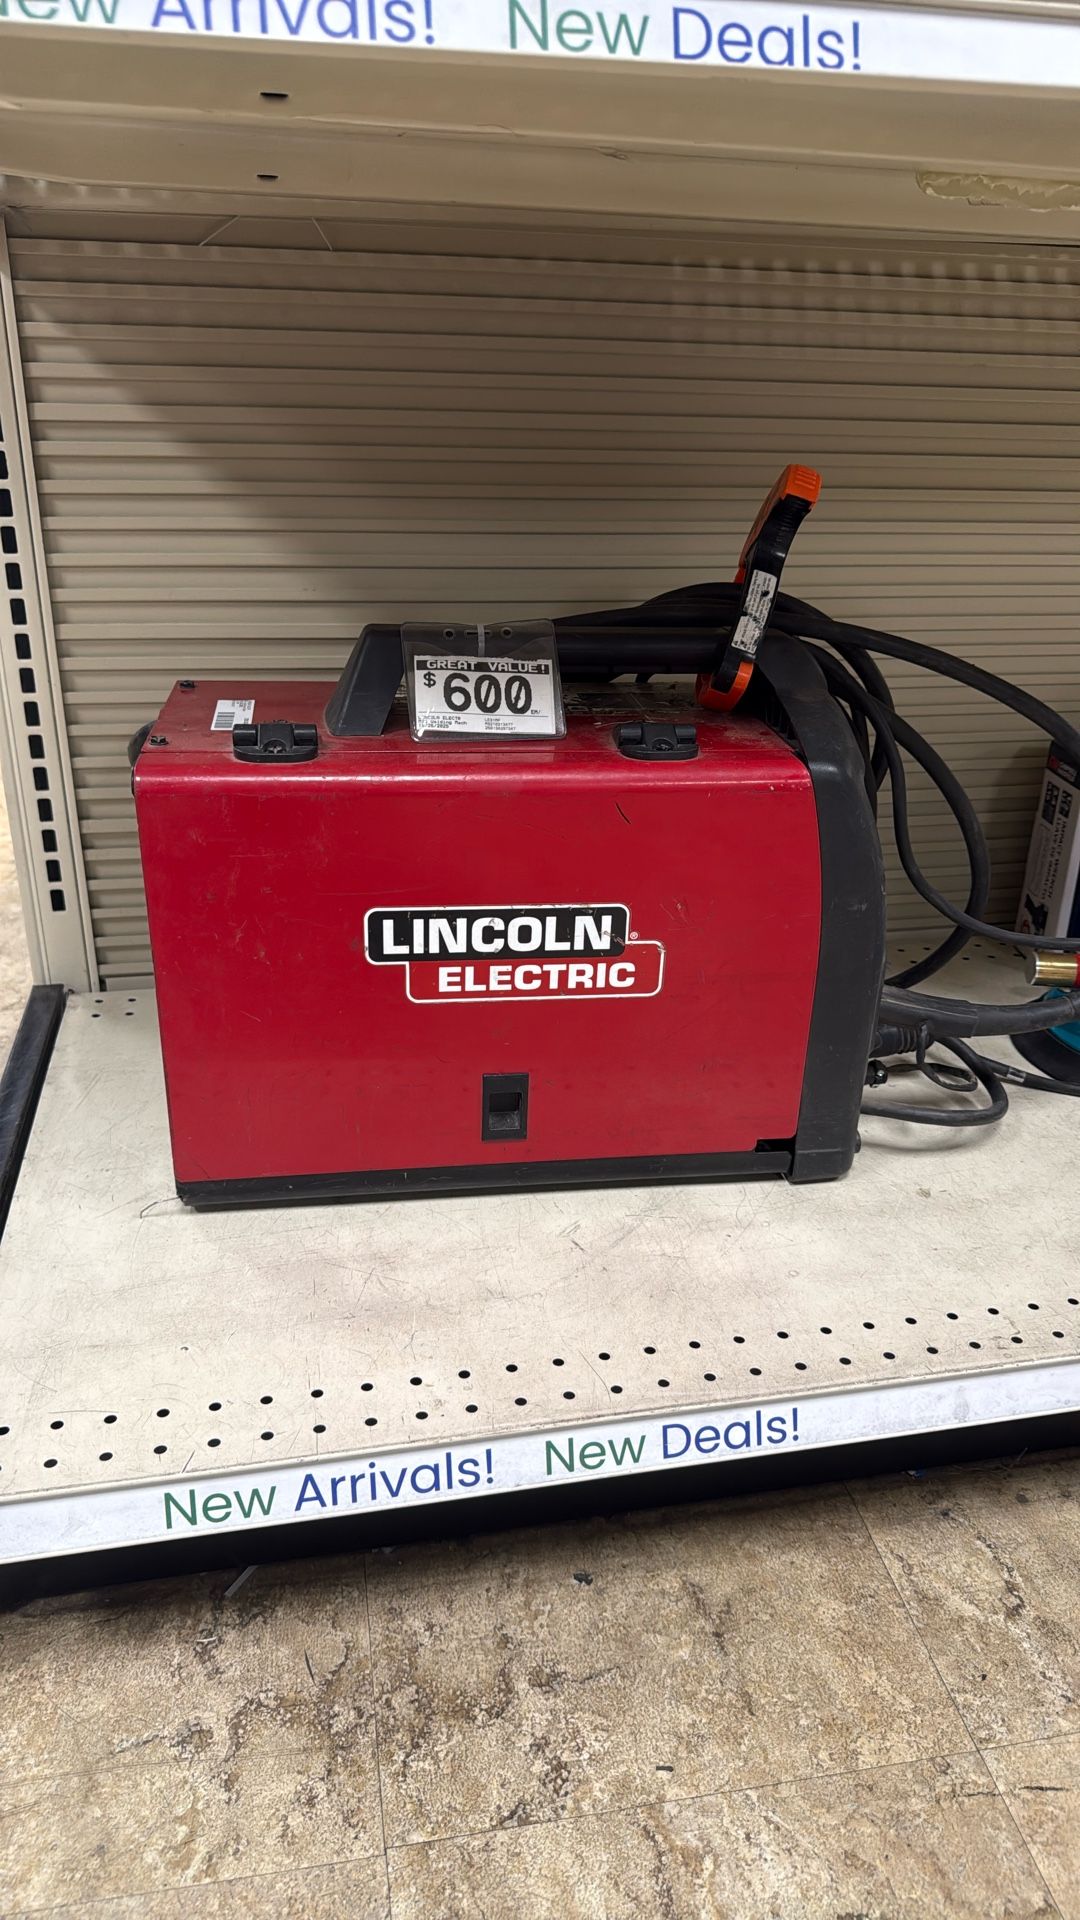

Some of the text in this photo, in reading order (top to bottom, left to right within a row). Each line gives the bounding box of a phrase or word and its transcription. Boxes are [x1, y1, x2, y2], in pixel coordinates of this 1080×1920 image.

[508, 0, 650, 56] New
[672, 7, 862, 70] Deals!
[426, 660, 547, 674] GREAT VALUE!
[382, 915, 612, 955] LINCOLN
[438, 962, 636, 993] ELECTRIC
[164, 1407, 799, 1529] New Arrivals! New Deals!
